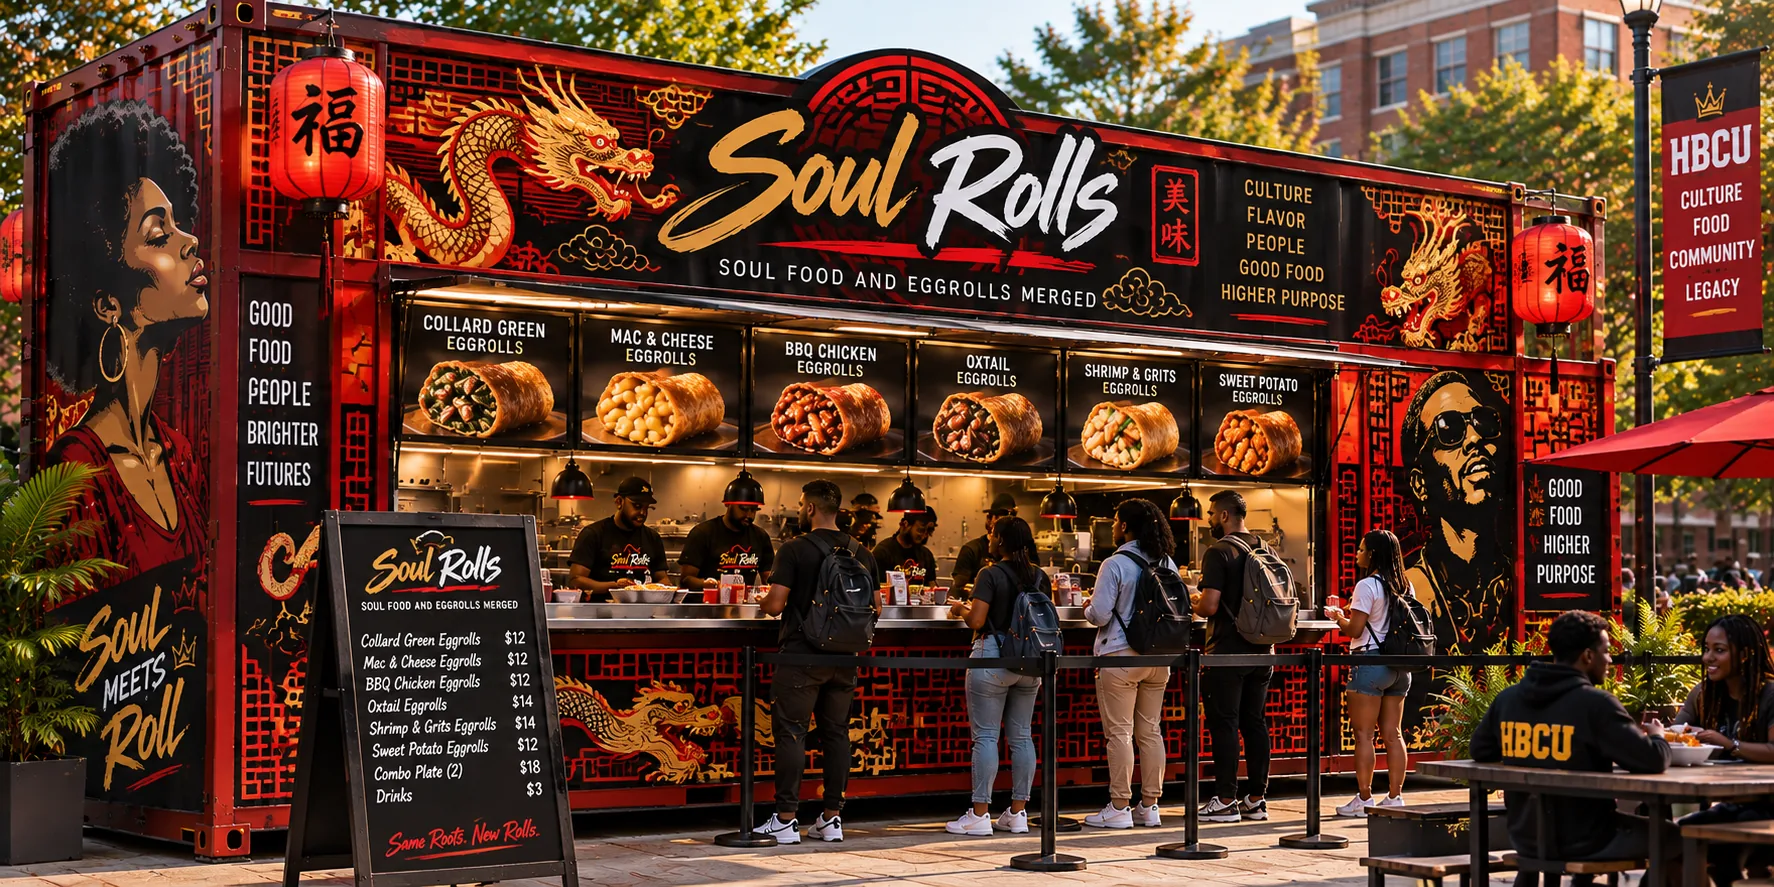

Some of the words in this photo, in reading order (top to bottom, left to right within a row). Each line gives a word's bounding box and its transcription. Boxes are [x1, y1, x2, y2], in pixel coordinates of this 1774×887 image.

[292, 85, 363, 157] 福
[1671, 124, 1751, 175] HBCU
[658, 108, 918, 253] Soul
[926, 133, 1118, 252] Rolls
[1245, 180, 1312, 203] CULTURE
[1681, 183, 1742, 209] CULTURE
[1161, 177, 1191, 254] 美味
[1248, 206, 1305, 229] FLAVOR
[1694, 214, 1729, 235] FOOD
[1247, 233, 1304, 254] PEOPLE
[1670, 240, 1754, 269] COMMUNITY
[1240, 259, 1279, 277] GOOD
[1287, 264, 1323, 282] FOOD
[1546, 243, 1589, 293] 福
[720, 259, 775, 279] SOUL
[788, 265, 843, 285] FOOD
[855, 272, 895, 289] AND
[909, 276, 1010, 300] EGGROLLS
[1022, 286, 1095, 307] MERGED
[1687, 278, 1739, 301] LEGACY
[1222, 284, 1275, 304] HIGHER
[1282, 290, 1345, 310] PURPOSE
[250, 300, 292, 327] GOOD
[424, 315, 491, 333] COLLARD
[498, 320, 544, 338] GREEN
[448, 336, 522, 354] EGGROLLS
[611, 329, 641, 345] MAC
[647, 331, 656, 345] &
[662, 332, 713, 349] CHEESE
[250, 338, 291, 364] FOOD
[627, 349, 695, 365] EGGROLLS
[786, 342, 812, 358] BBQ
[819, 344, 876, 361] CHICKEN
[798, 361, 863, 377] EGGROLLS
[967, 355, 1010, 371] OXTAIL
[958, 372, 1016, 387] EGGROLLS
[1085, 364, 1128, 379] SHRIMP
[1133, 367, 1140, 380] &
[1145, 368, 1175, 382] GRITS
[1220, 374, 1255, 388] SWEET
[1260, 376, 1297, 391] POTATO
[1103, 382, 1157, 396] EGGROLLS
[1233, 391, 1282, 405] EGGROLLS
[248, 421, 318, 446] BRIGHTER
[248, 462, 310, 486] FUTURES
[1549, 479, 1582, 497] GOOD
[1550, 506, 1581, 525] FOOD
[1545, 535, 1589, 554] HIGHER
[365, 547, 435, 594] Soul
[438, 545, 501, 587] Rolls
[1538, 565, 1595, 583] PURPOSE
[362, 602, 385, 611] SOUL
[388, 601, 411, 610] FOOD
[415, 601, 432, 609] AND
[436, 601, 480, 609] EGGROLLS
[484, 601, 518, 609] MERGED
[75, 583, 173, 693] Soul
[361, 633, 401, 648] Collard
[404, 633, 435, 647] Green
[439, 632, 480, 650] Eggrolls
[505, 630, 525, 645] $12
[389, 655, 397, 669] &
[401, 655, 436, 668] Cheese
[440, 653, 481, 671] Eggrolls
[508, 652, 528, 666] $12
[103, 652, 165, 711] MEETS
[366, 677, 390, 692] BBQ
[395, 675, 435, 690] Chicken
[440, 674, 480, 692] Eggrolls
[510, 673, 530, 687] $12
[368, 698, 400, 713] Oxtail
[404, 697, 447, 715] Eggrolls
[513, 695, 533, 708] $14
[370, 721, 408, 738] Shrimp
[412, 720, 420, 733] &
[425, 719, 451, 733] Grits
[455, 717, 496, 735] Eggrolls
[515, 716, 535, 730] $14
[100, 677, 190, 792] Roll
[518, 737, 538, 751] $12
[1501, 722, 1574, 760] HBCU
[372, 743, 405, 758] Sweet
[409, 742, 442, 756] Potato
[447, 739, 488, 757] Eggrolls
[375, 766, 411, 781] Combo
[415, 764, 442, 779] Plate
[447, 763, 462, 779] (2)
[520, 760, 540, 774] $18
[377, 787, 412, 803] Drinks
[527, 782, 542, 797] $3
[385, 832, 425, 858] Same
[429, 827, 466, 849] Roots.
[472, 823, 500, 845] New
[503, 819, 540, 842] Rolls.
